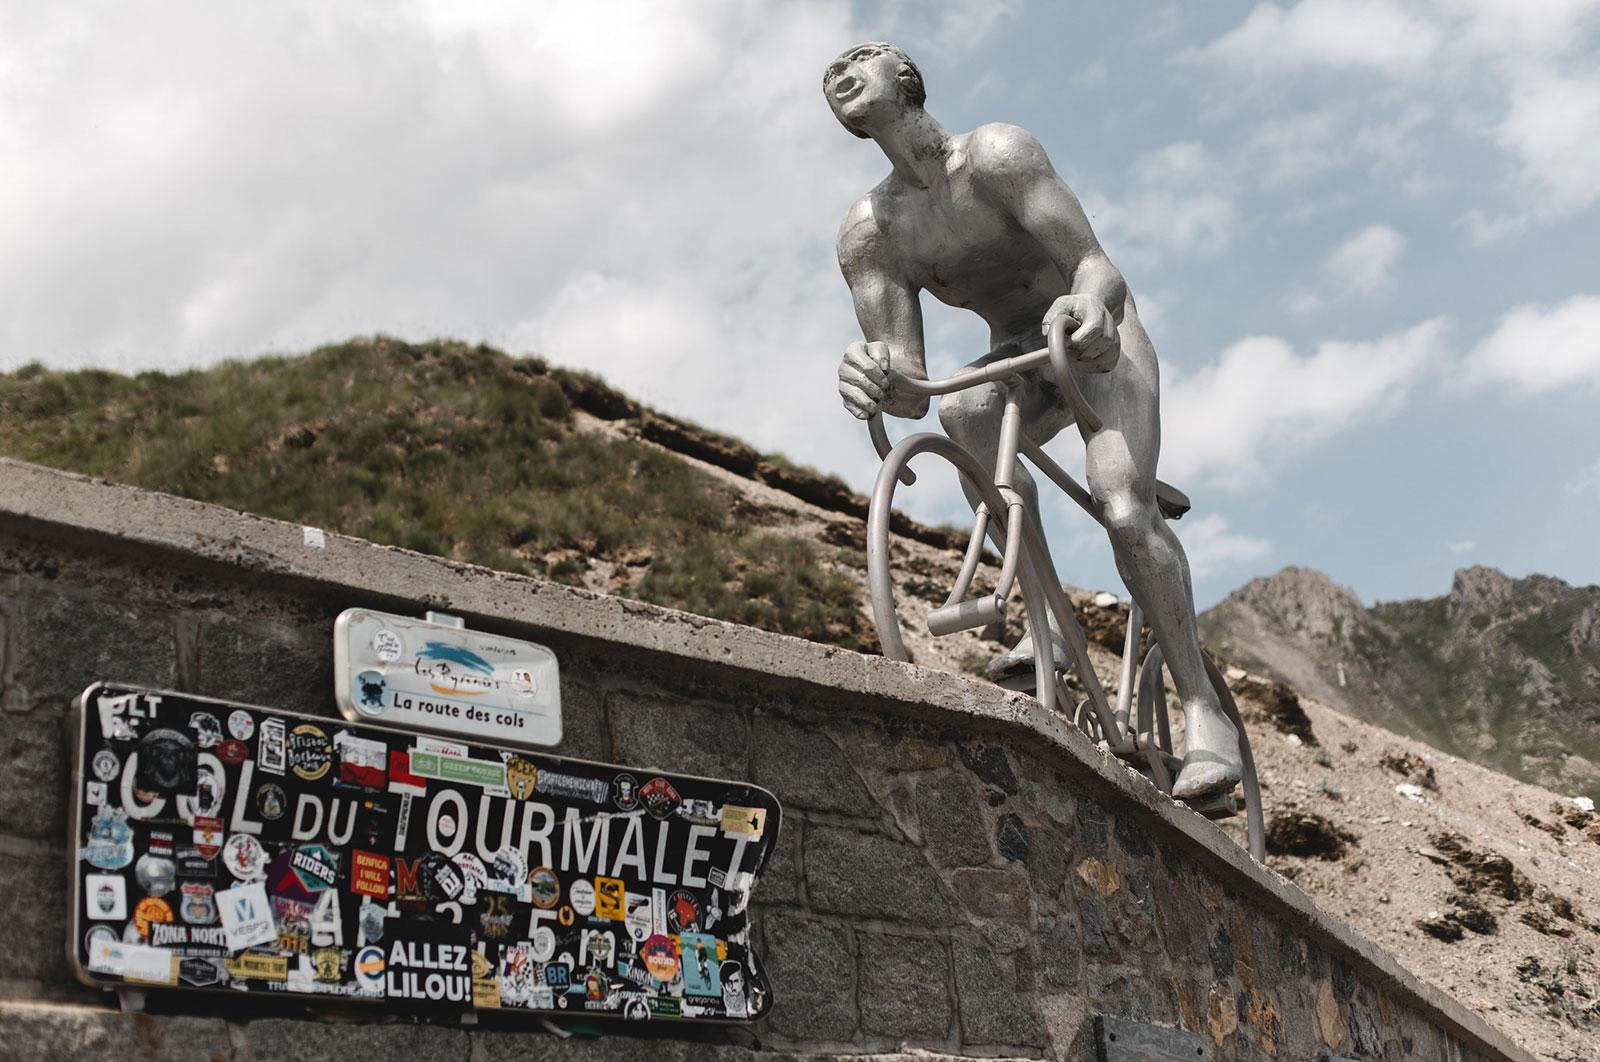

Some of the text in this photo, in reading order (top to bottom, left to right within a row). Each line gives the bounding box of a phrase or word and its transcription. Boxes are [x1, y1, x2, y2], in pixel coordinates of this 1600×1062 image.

[393, 693, 524, 728] La route des cols
[120, 751, 264, 835] COL
[291, 793, 358, 846] DU
[388, 780, 761, 891] TOURMALET
[293, 852, 336, 884] RIDERS
[357, 854, 388, 870] BENFICA
[356, 880, 386, 895] FOLLOW
[365, 871, 381, 883] WILL
[152, 923, 228, 947] ZONA NORT
[389, 940, 468, 971] ALLEZ
[387, 971, 472, 1002] LILOU!
[546, 965, 568, 985] BR
